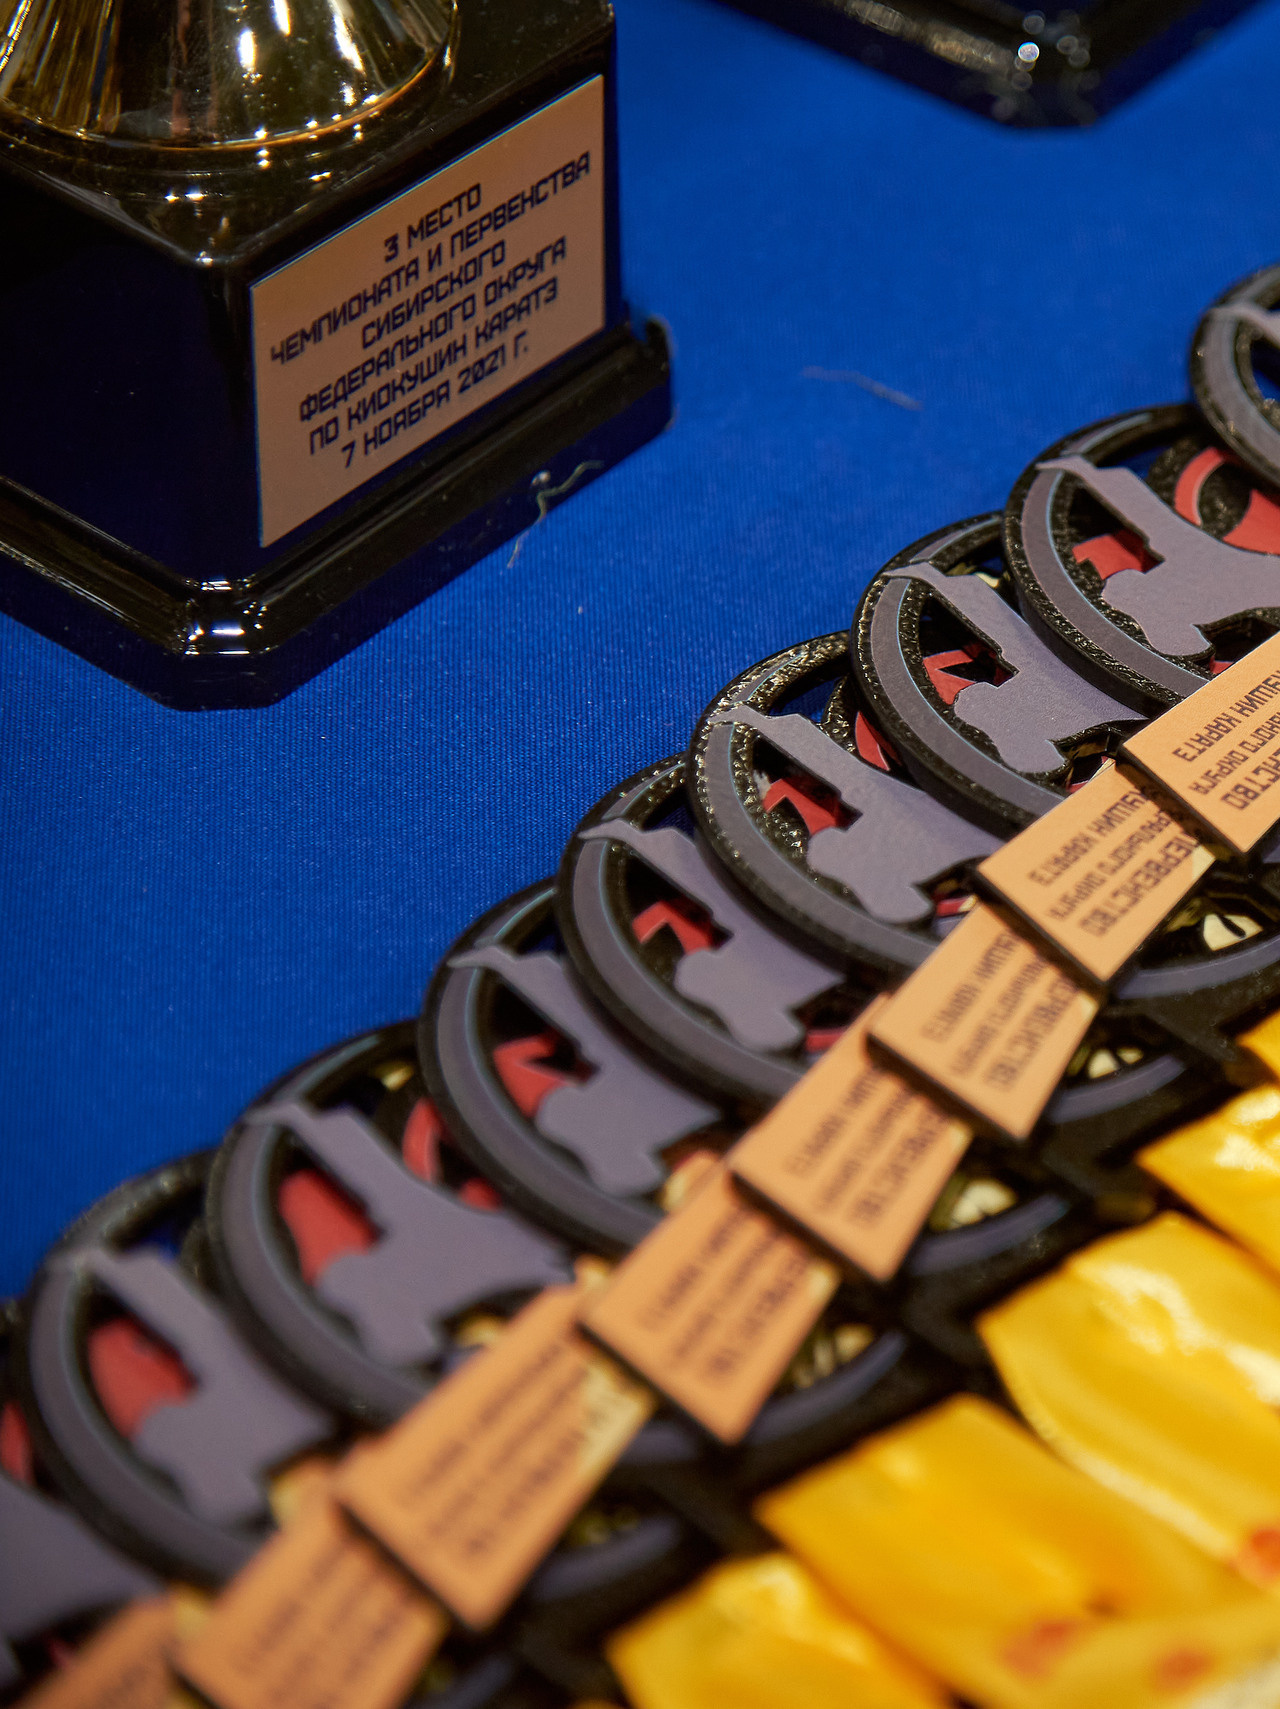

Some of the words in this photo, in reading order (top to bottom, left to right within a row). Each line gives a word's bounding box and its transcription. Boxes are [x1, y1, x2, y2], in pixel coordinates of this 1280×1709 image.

[271, 257, 420, 366] ЧЕМПИОНАТА
[428, 243, 442, 272] И
[451, 151, 591, 259] ПЕРВЕНСТВА
[384, 233, 399, 263] 3
[407, 183, 482, 249] МЕСТО
[300, 299, 475, 422] ФЕДЕРАЛЬНОГО
[485, 235, 566, 308] ОКРУГА
[362, 239, 506, 349] СИБИРСКОГО
[309, 417, 339, 455] ПО
[348, 335, 467, 432] КИОКУШИН
[475, 276, 558, 345] КАРАТЭ
[342, 442, 357, 468] 7
[363, 379, 450, 456] НОЯБРЯ
[458, 345, 507, 395] 2021
[514, 331, 530, 359] Г.
[1173, 712, 1242, 762] КАРАТЭ
[1188, 748, 1249, 795] ОКРУГА
